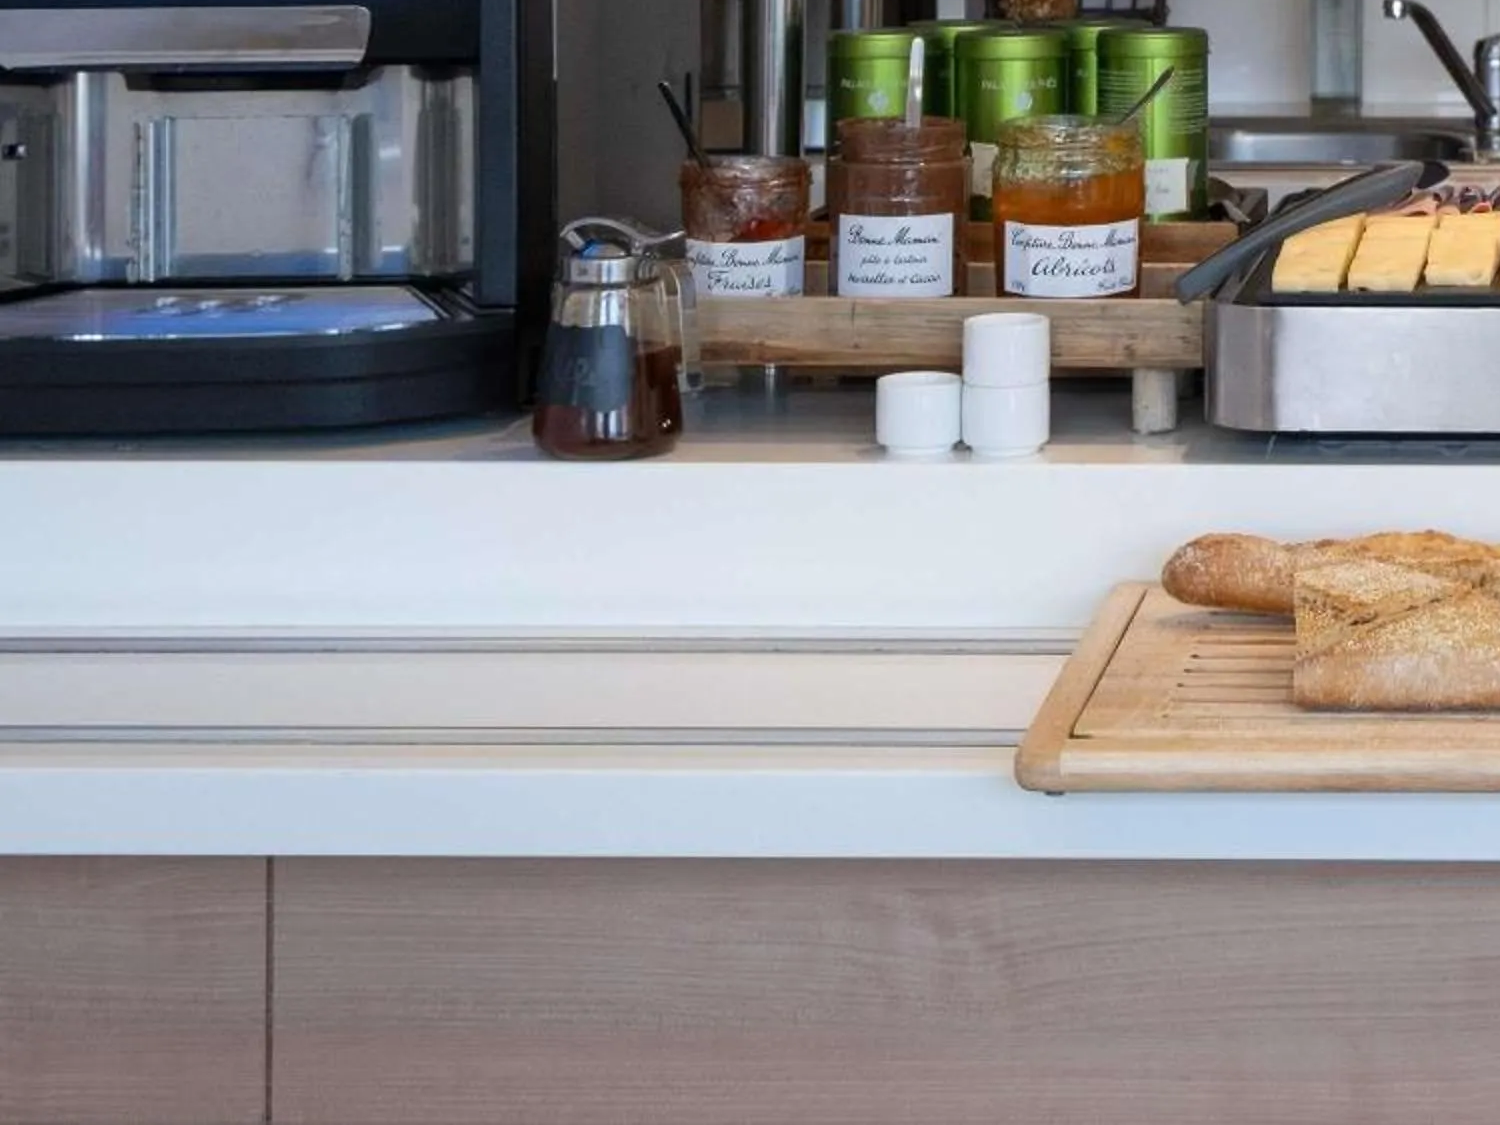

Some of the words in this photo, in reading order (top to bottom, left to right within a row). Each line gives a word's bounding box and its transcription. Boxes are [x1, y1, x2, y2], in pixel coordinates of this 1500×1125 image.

[845, 223, 890, 246] Bonne
[893, 225, 943, 246] Maman
[1056, 230, 1099, 250] Bonne
